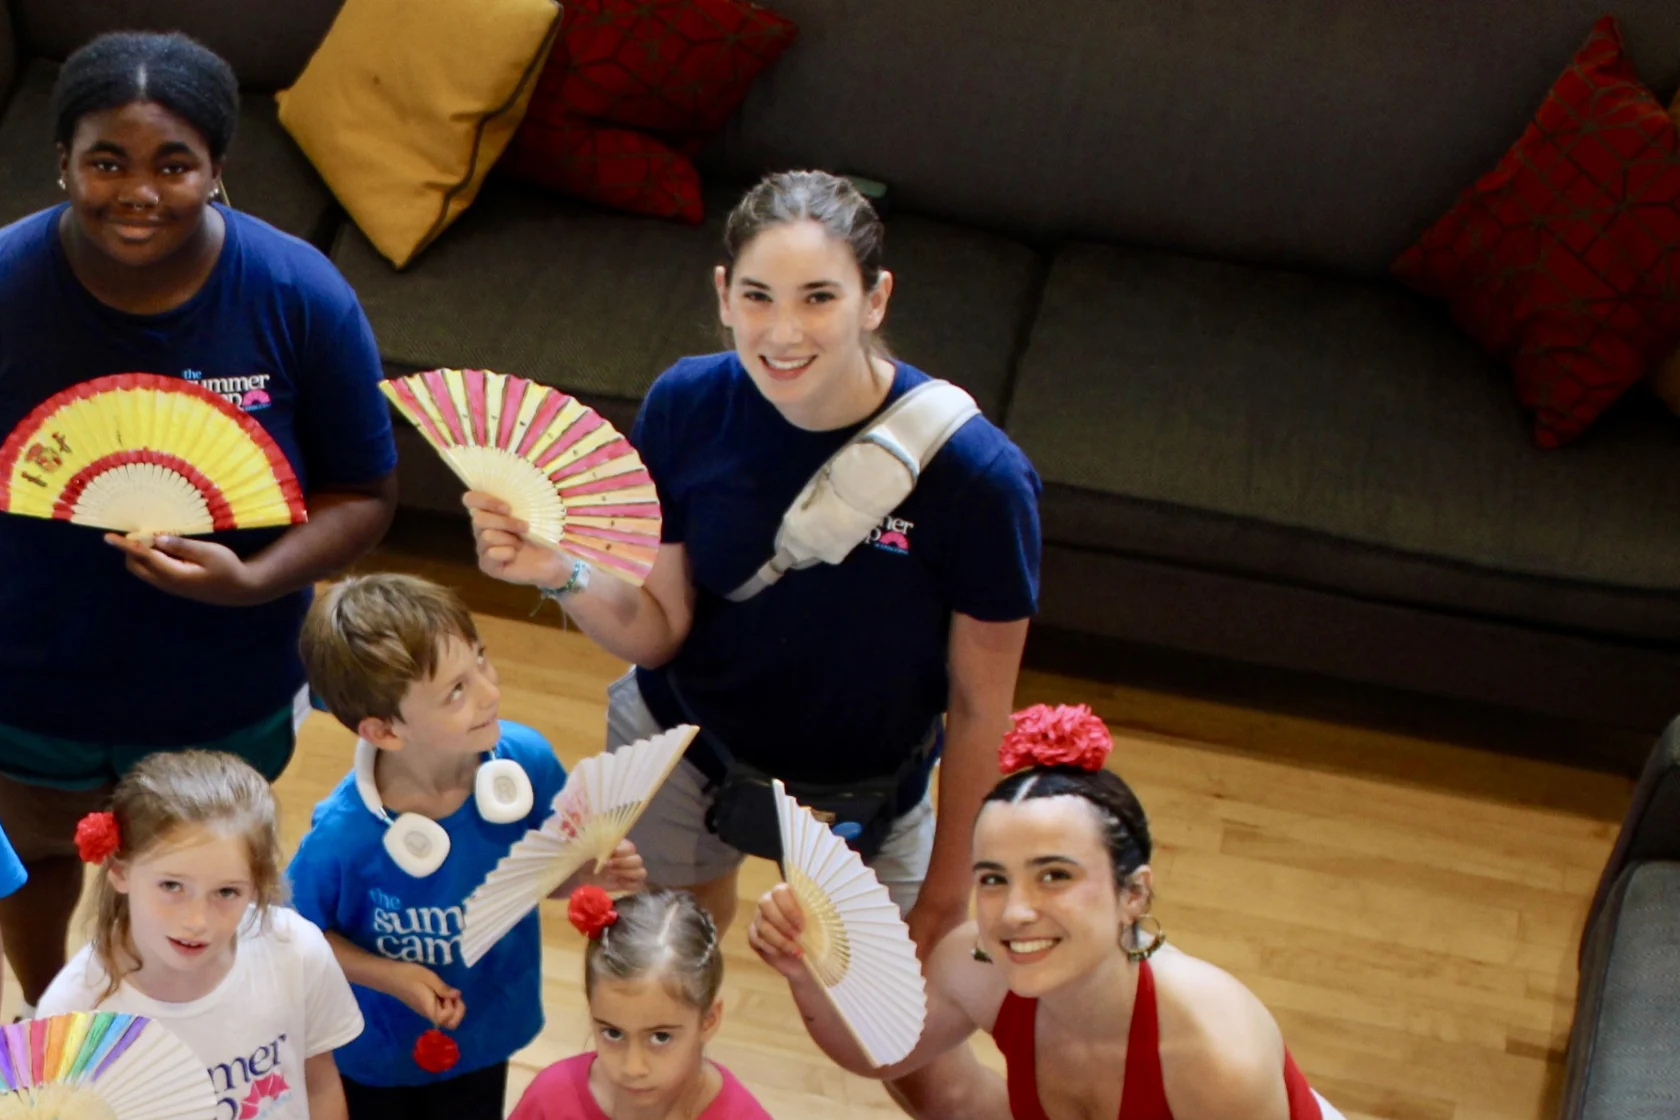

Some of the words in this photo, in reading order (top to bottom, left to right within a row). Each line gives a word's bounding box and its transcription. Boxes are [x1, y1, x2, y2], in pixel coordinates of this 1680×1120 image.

[183, 369, 202, 380] the
[373, 905, 465, 936] sum
[377, 935, 463, 965] cam
[207, 1033, 287, 1095] mer
